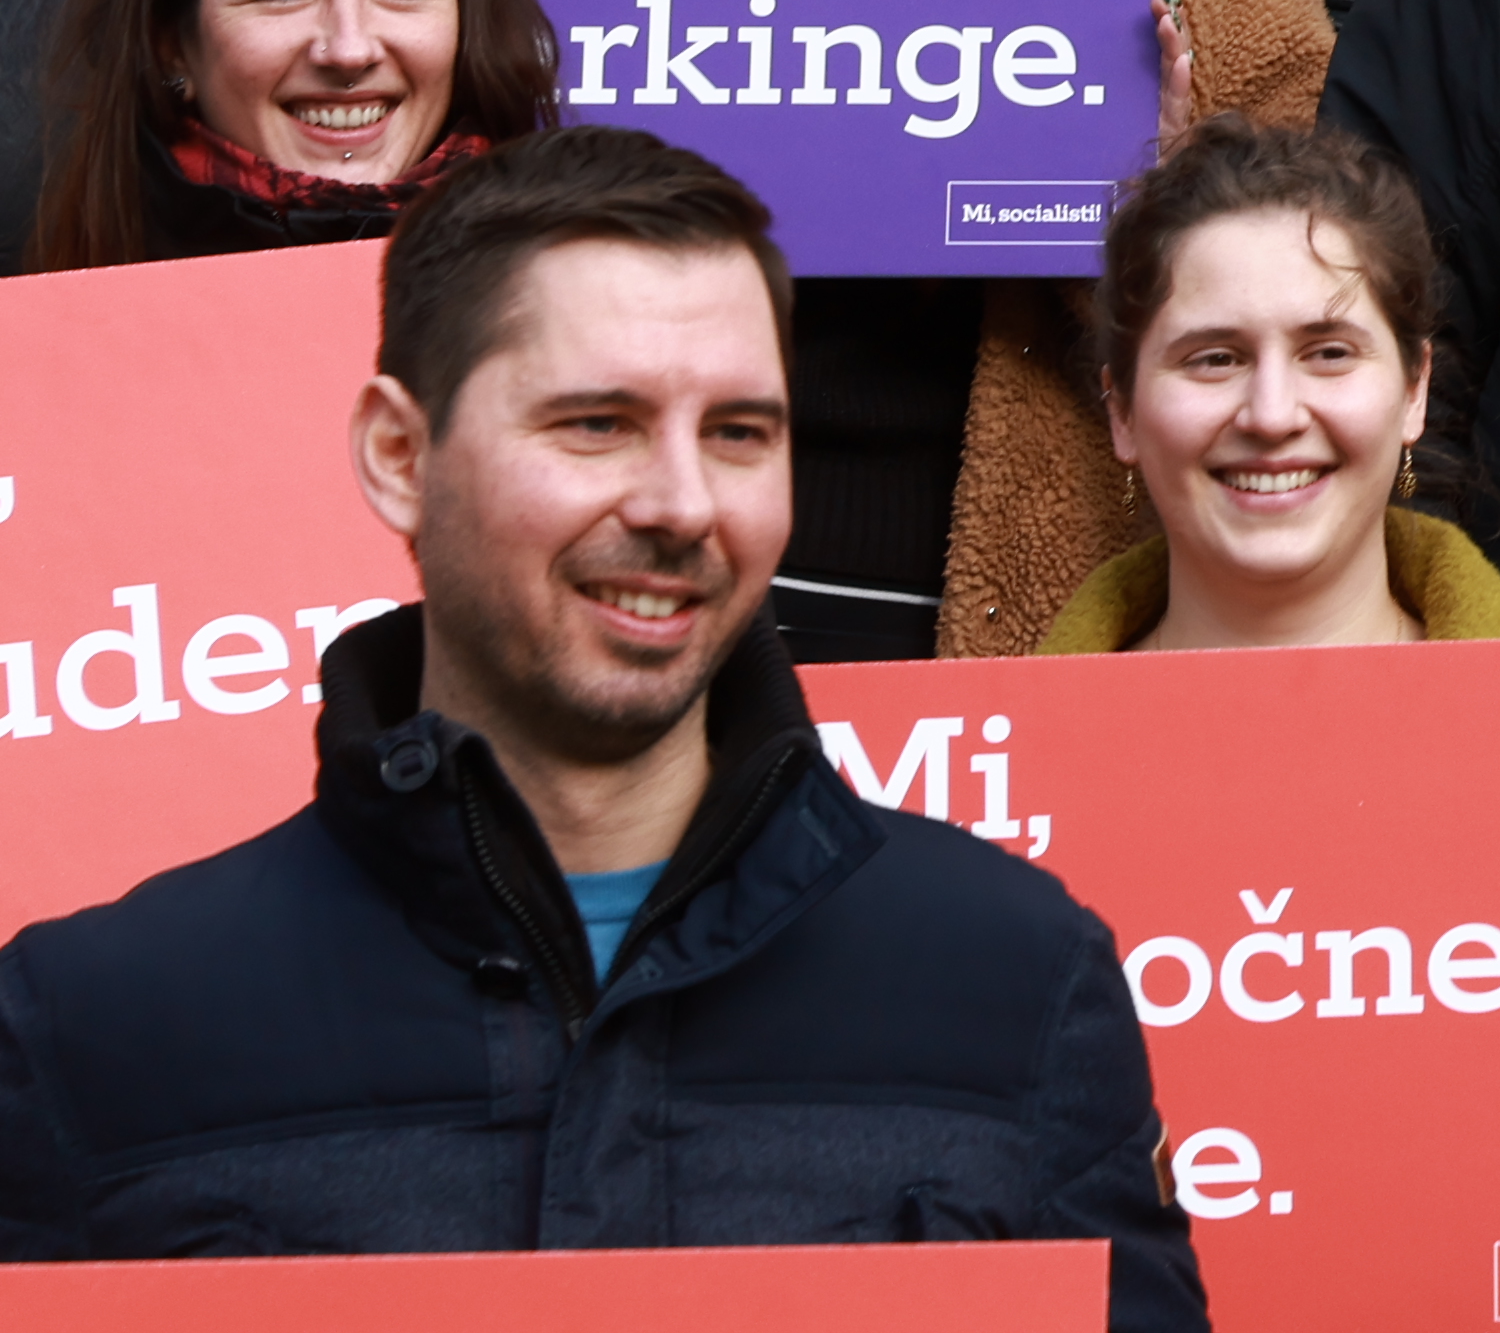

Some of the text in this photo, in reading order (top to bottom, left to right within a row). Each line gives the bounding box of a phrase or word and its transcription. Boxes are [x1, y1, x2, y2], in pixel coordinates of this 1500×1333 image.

[962, 204, 1101, 224] Mi, socialisti!
[815, 714, 1052, 859] Mi,
